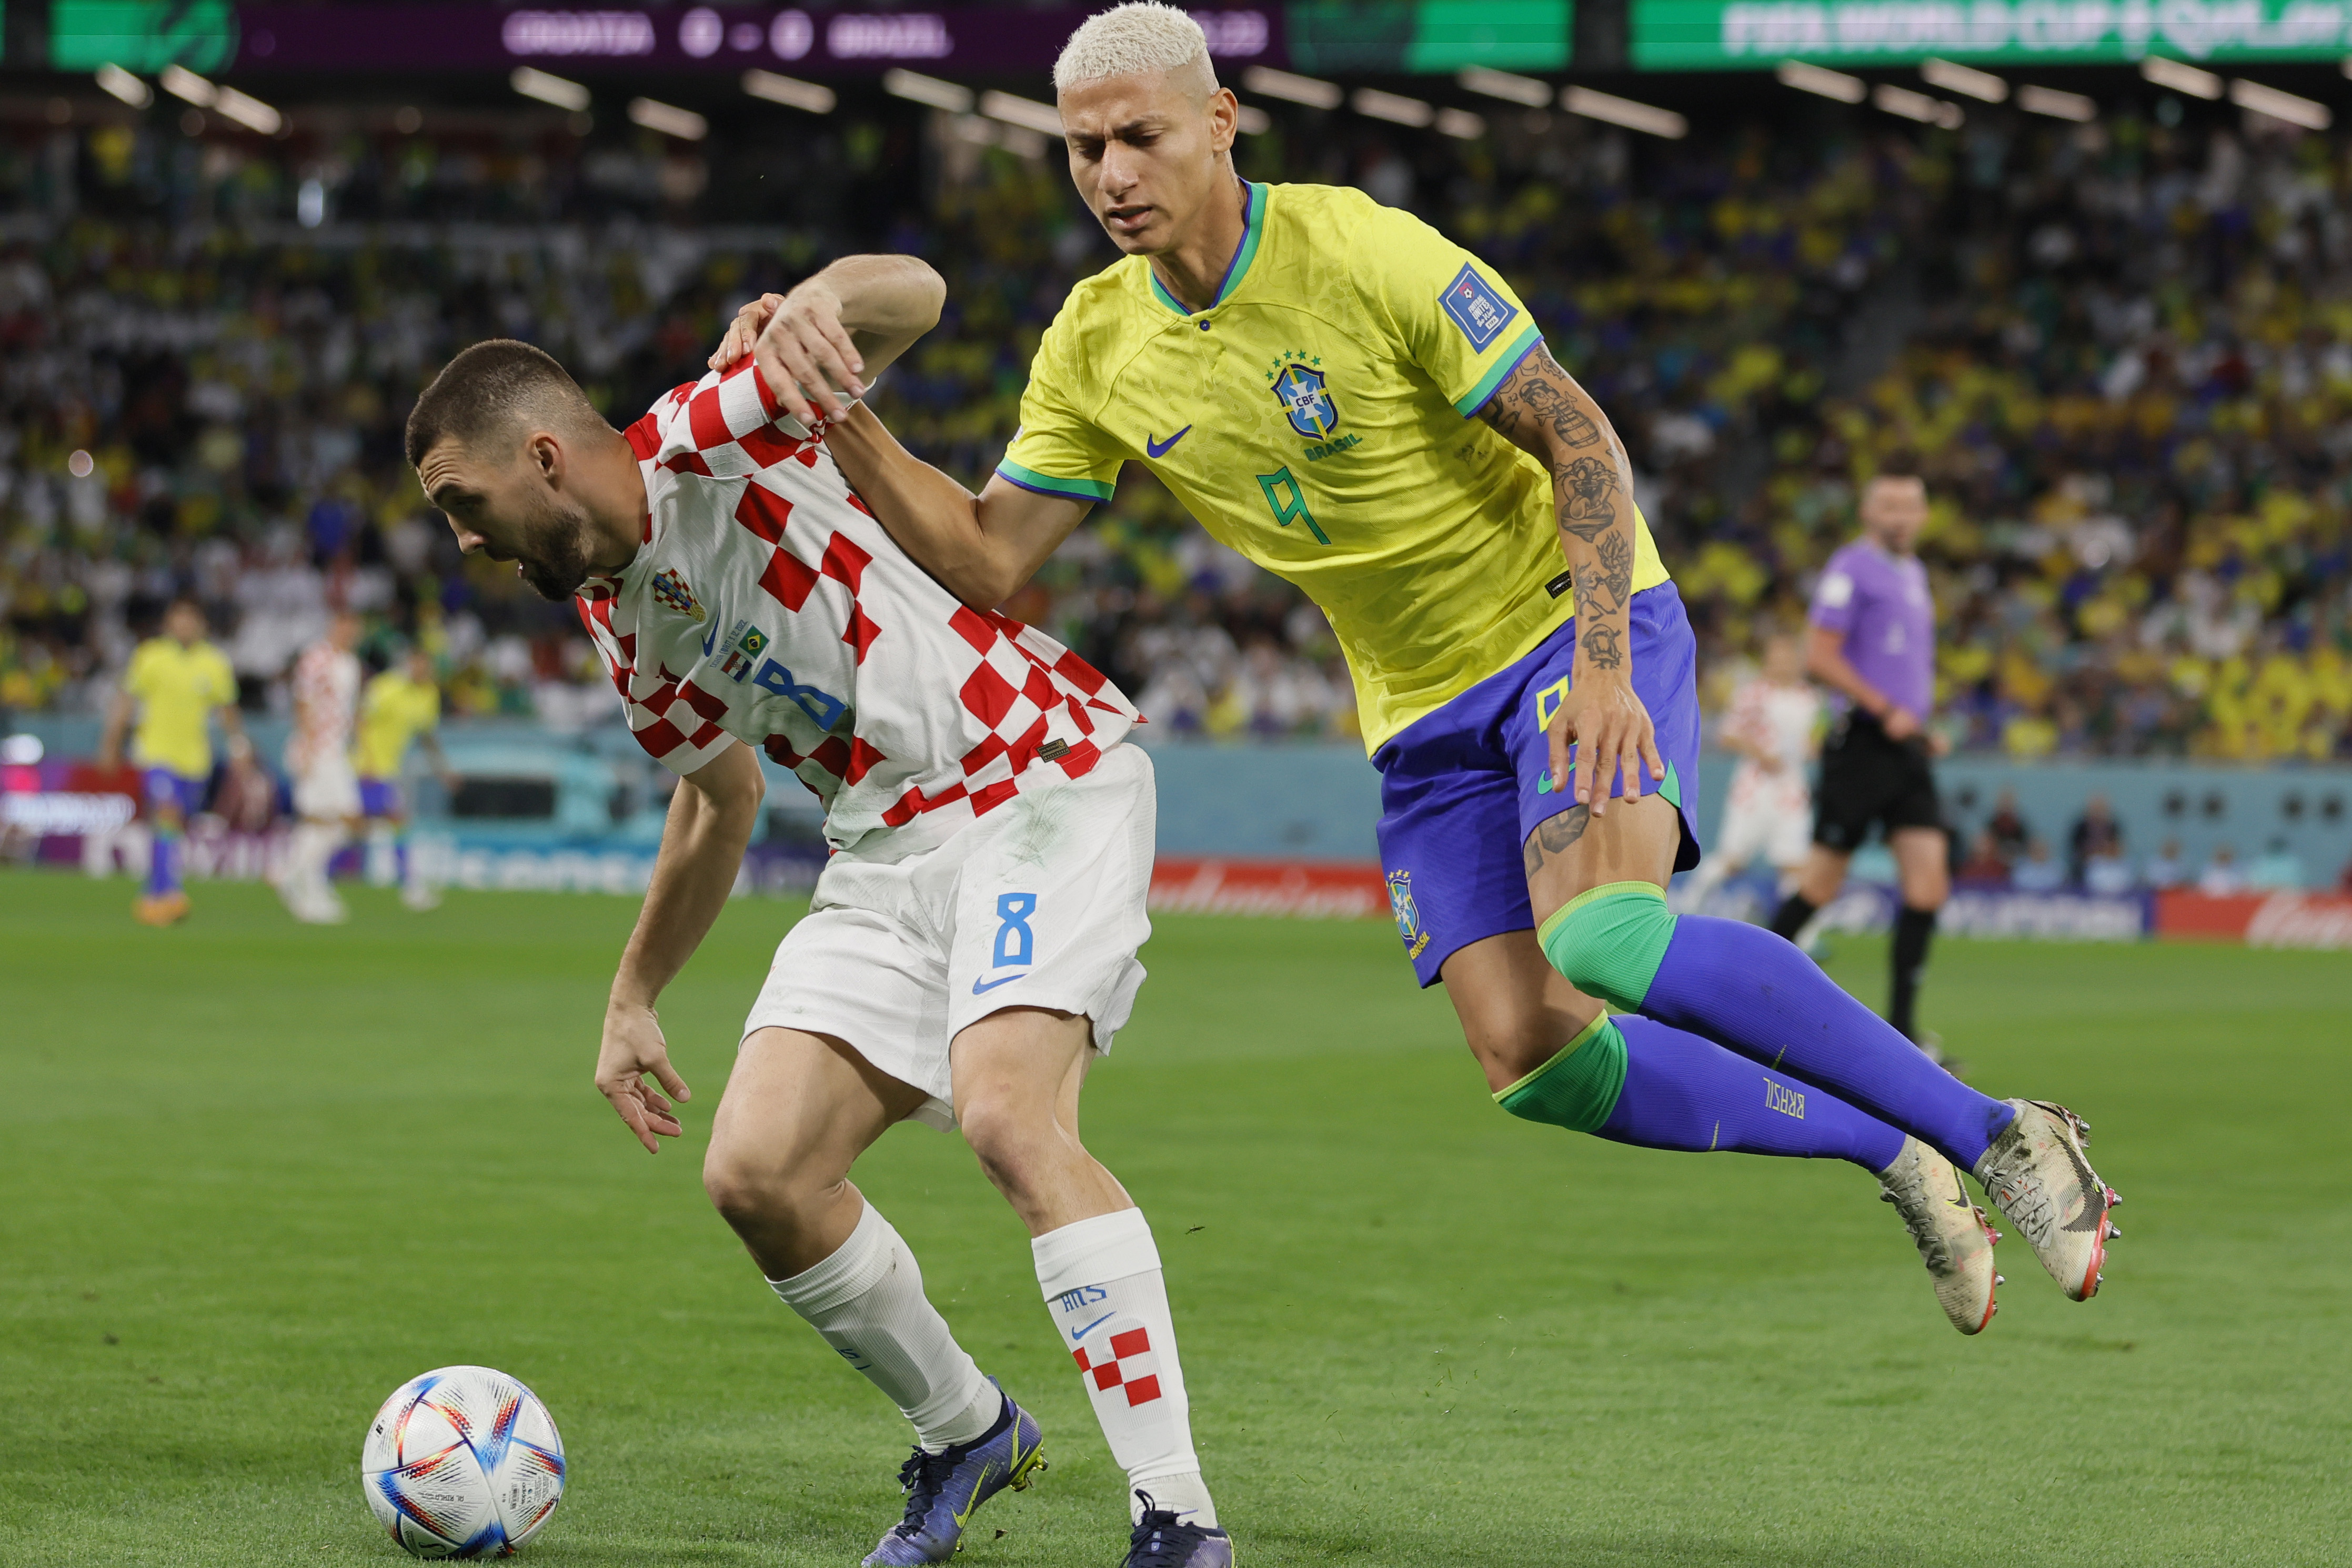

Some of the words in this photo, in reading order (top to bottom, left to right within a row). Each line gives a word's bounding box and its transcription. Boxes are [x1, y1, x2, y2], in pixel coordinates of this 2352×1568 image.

[1468, 294, 1484, 314] FOOTBALL
[1472, 299, 1490, 320] UNITES
[1487, 318, 1497, 327] FIFA
[1295, 394, 1315, 407] CBF
[1304, 434, 1363, 461] BRASIL
[1256, 466, 1332, 545] 9
[752, 658, 846, 732] 8
[993, 892, 1037, 969] 8
[1409, 931, 1431, 960] BRASIL
[1763, 1077, 1805, 1120] BRASIL
